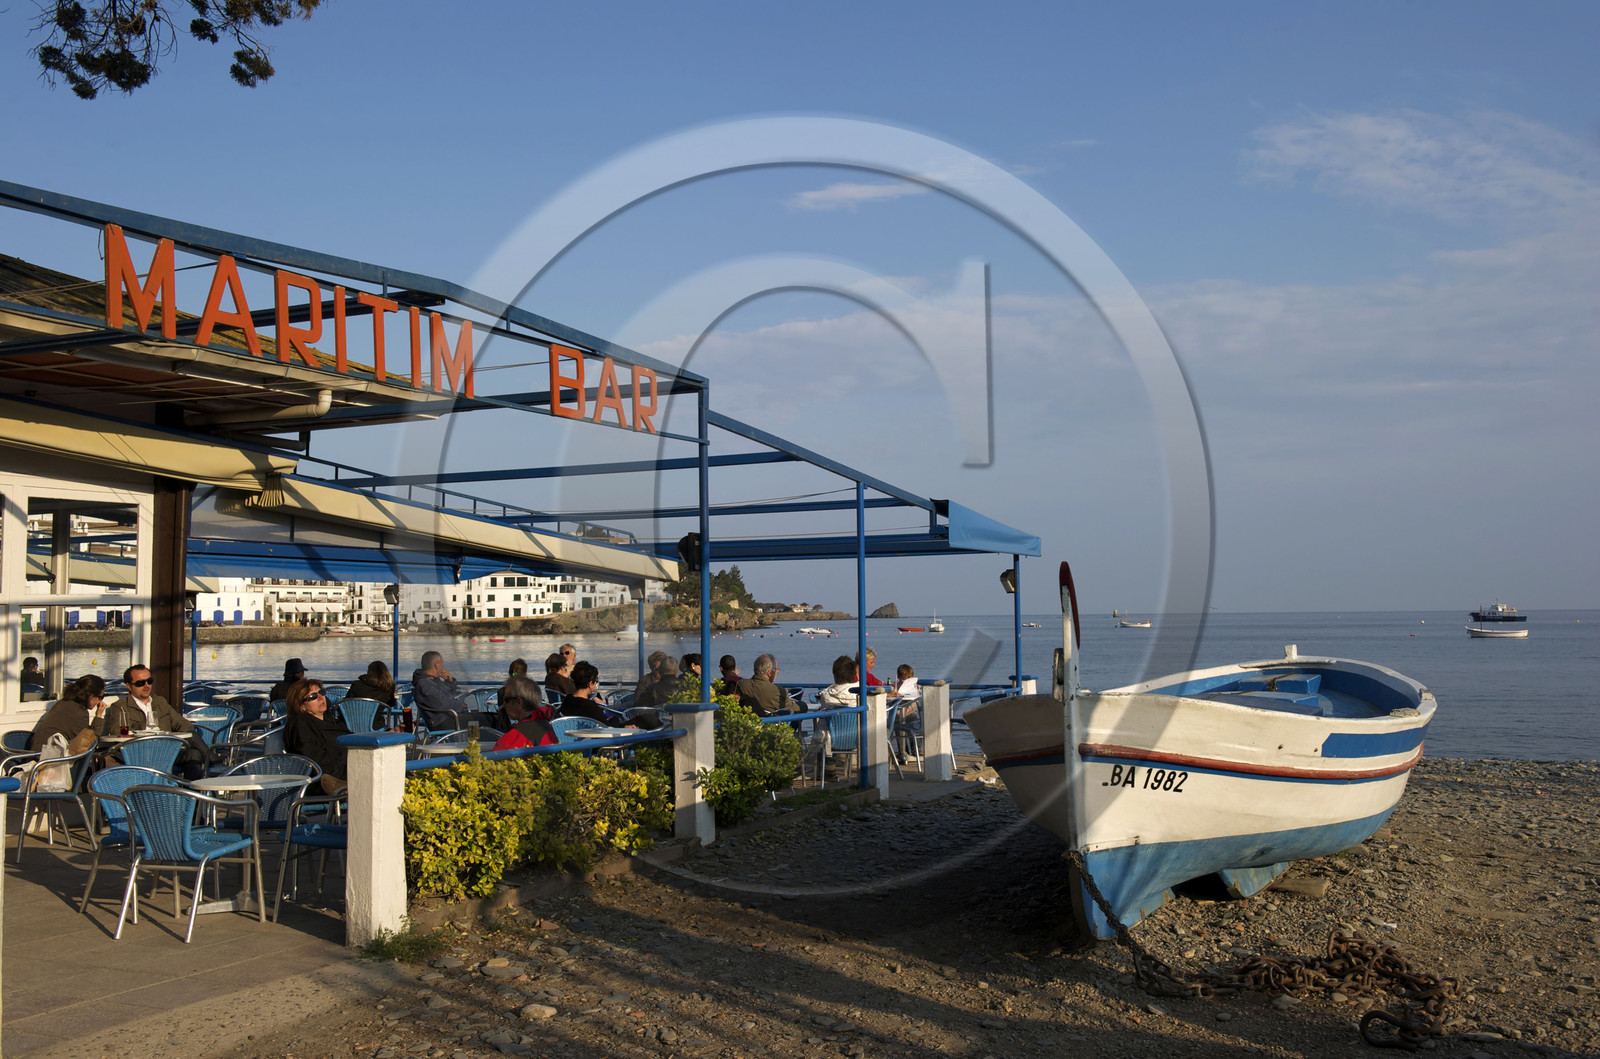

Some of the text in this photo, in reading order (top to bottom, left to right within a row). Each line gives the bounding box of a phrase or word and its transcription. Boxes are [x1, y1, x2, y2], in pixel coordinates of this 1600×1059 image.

[104, 223, 658, 434] MARITIM BAR
[1143, 768, 1188, 793] 1982
